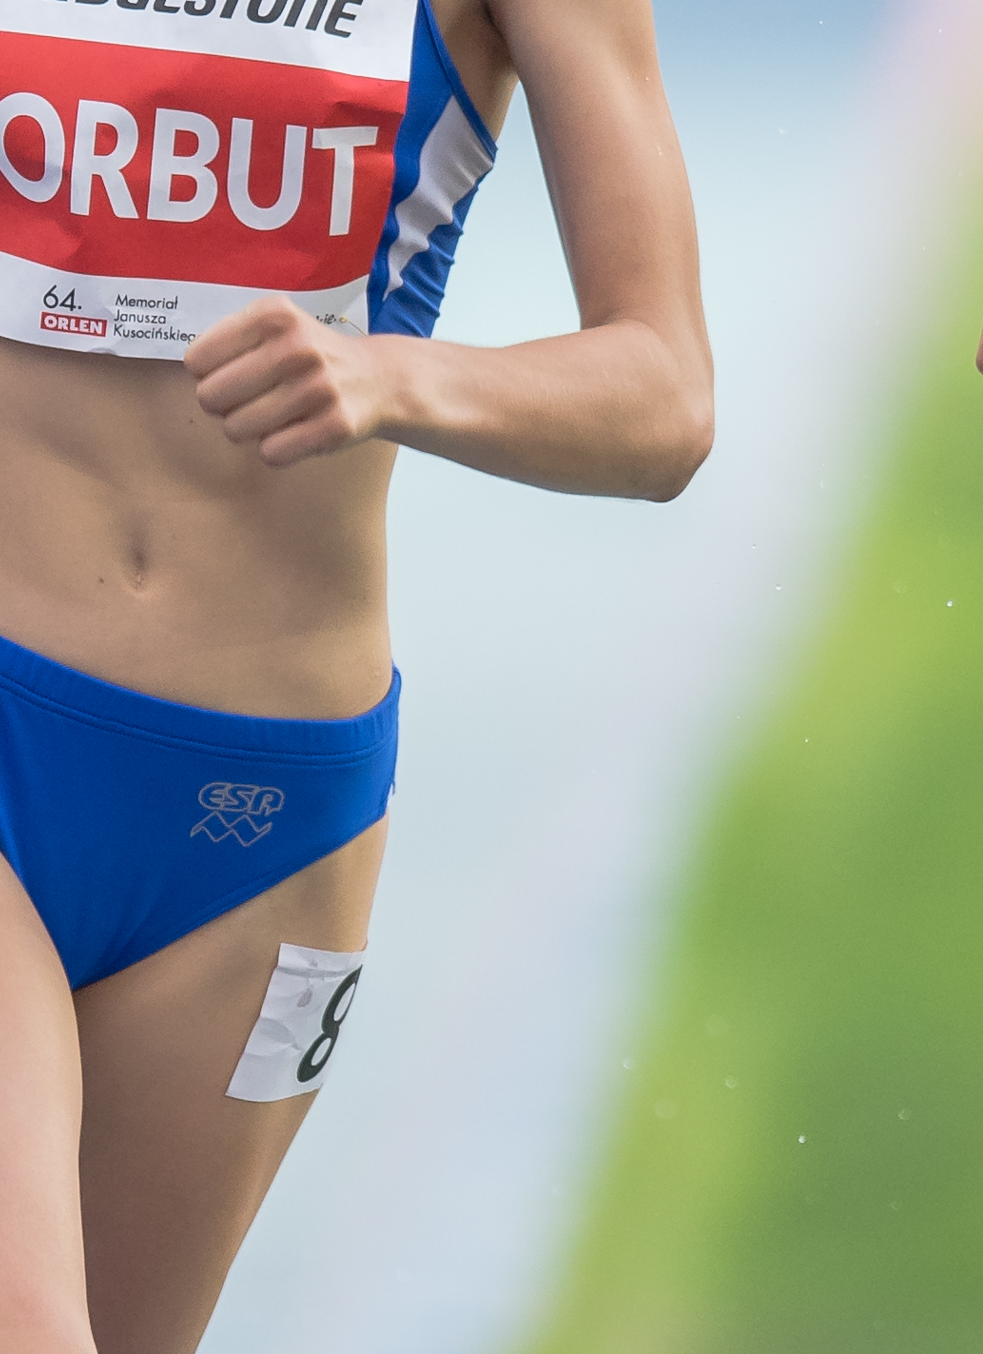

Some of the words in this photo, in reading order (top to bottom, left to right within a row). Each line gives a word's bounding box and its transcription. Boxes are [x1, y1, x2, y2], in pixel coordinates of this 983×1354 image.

[42, 284, 82, 311] 64.
[115, 294, 178, 310] Memoriał
[43, 314, 104, 336] ORLEN
[113, 309, 167, 324] Janusza
[113, 323, 197, 345] Kusocińskieg
[297, 964, 363, 1083] 8
